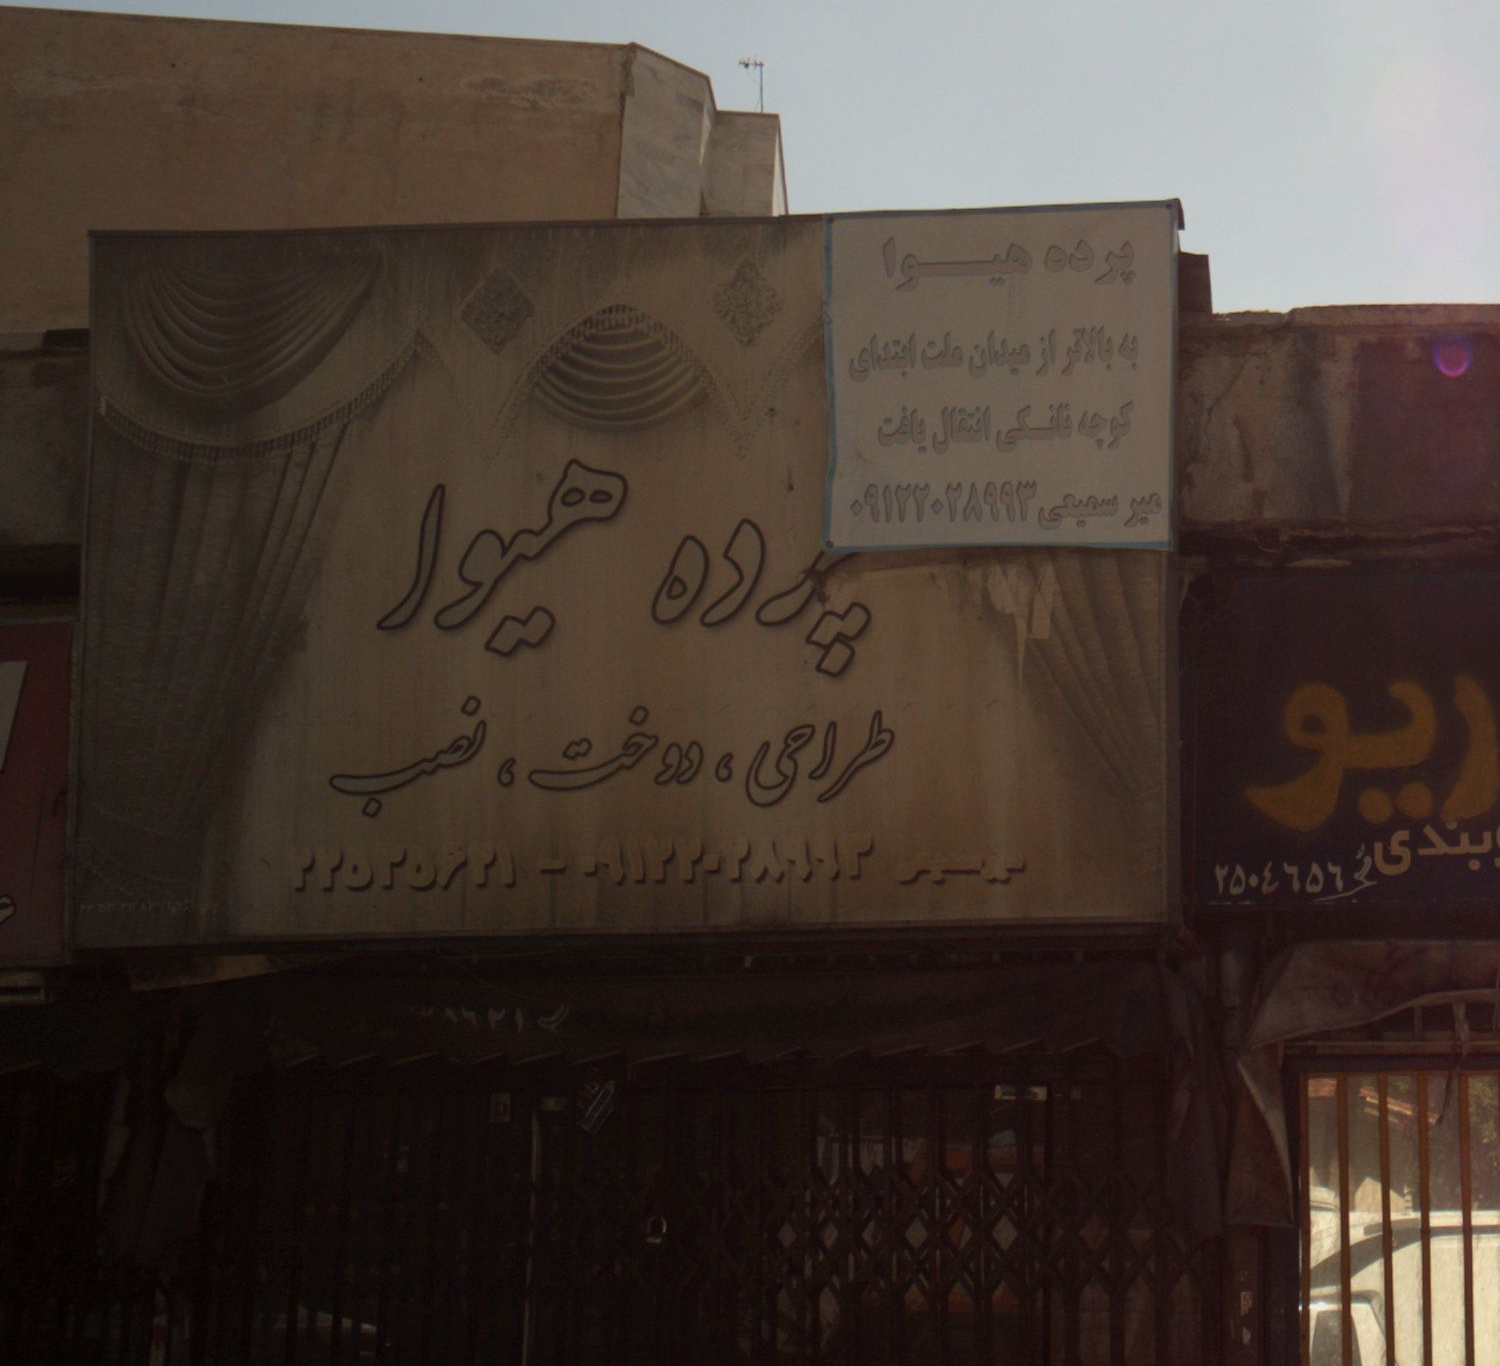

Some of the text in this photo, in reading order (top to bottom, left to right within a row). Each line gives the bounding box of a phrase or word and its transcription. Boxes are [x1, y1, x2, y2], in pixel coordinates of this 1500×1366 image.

[881, 236, 1136, 291] پرده هیوا
[849, 325, 1139, 383] به بالاتر از میدان ملت ابتدای
[877, 406, 927, 453] یافت
[932, 405, 991, 454] انتقال
[1077, 401, 1135, 449] کوچه
[377, 458, 628, 657] هیوا
[330, 695, 487, 818] نصب
[1242, 674, 1500, 833] ریو
